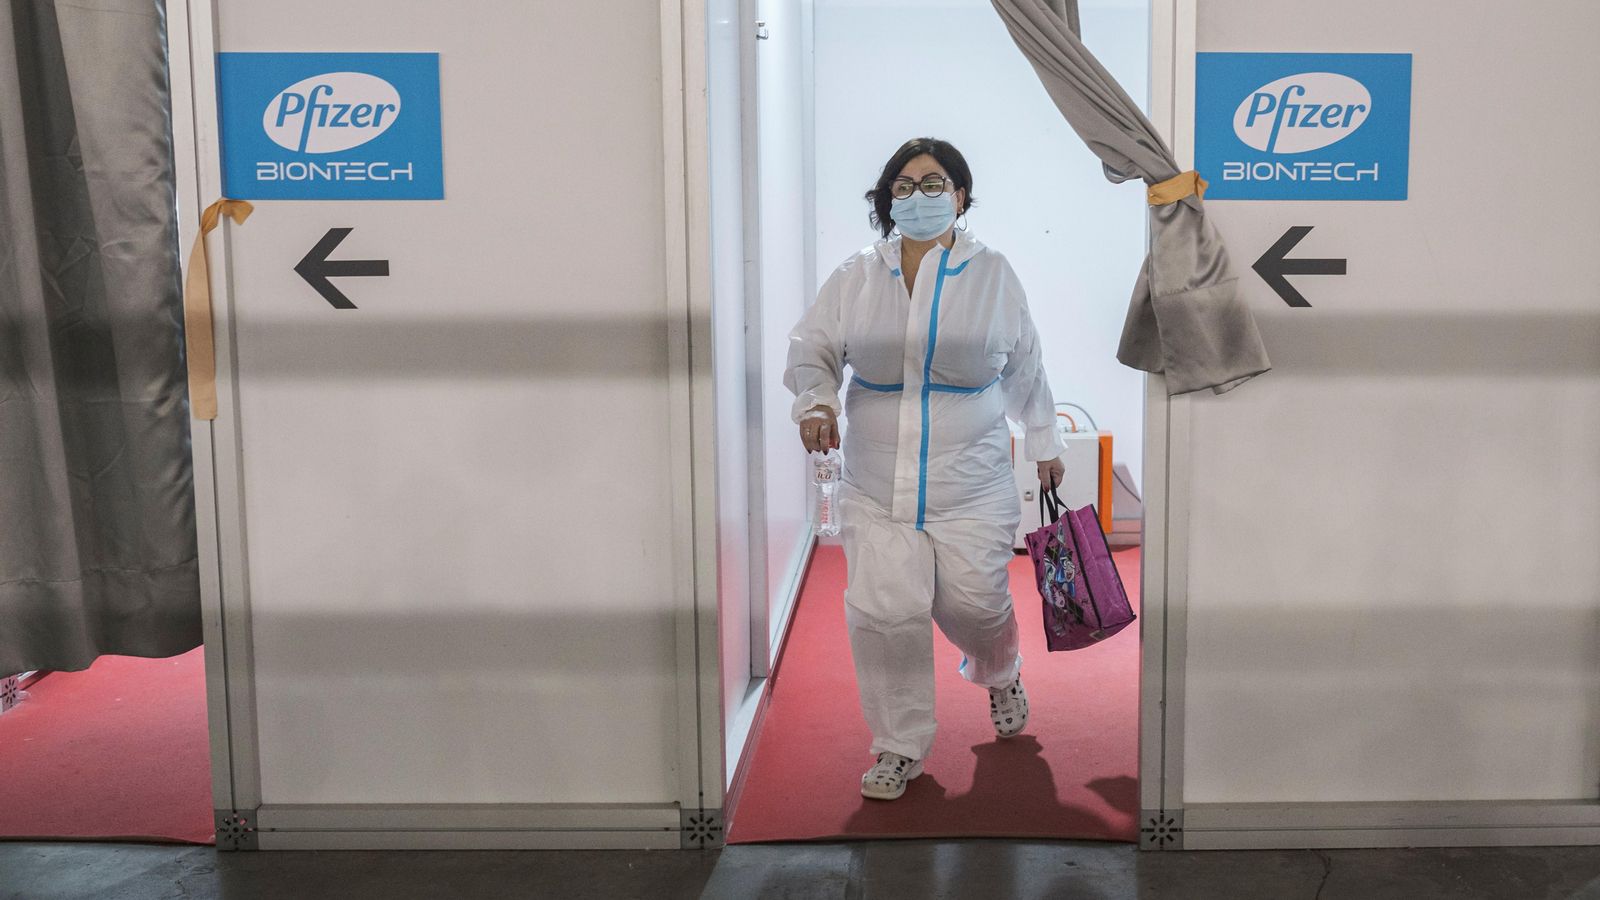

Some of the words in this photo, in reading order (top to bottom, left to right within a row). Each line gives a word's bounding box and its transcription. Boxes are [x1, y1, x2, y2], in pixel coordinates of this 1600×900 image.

[275, 84, 396, 152] Pfizer
[1245, 84, 1366, 152] Pfizer
[256, 162, 413, 181] BIONTECH
[1223, 162, 1378, 181] BIONTECH
